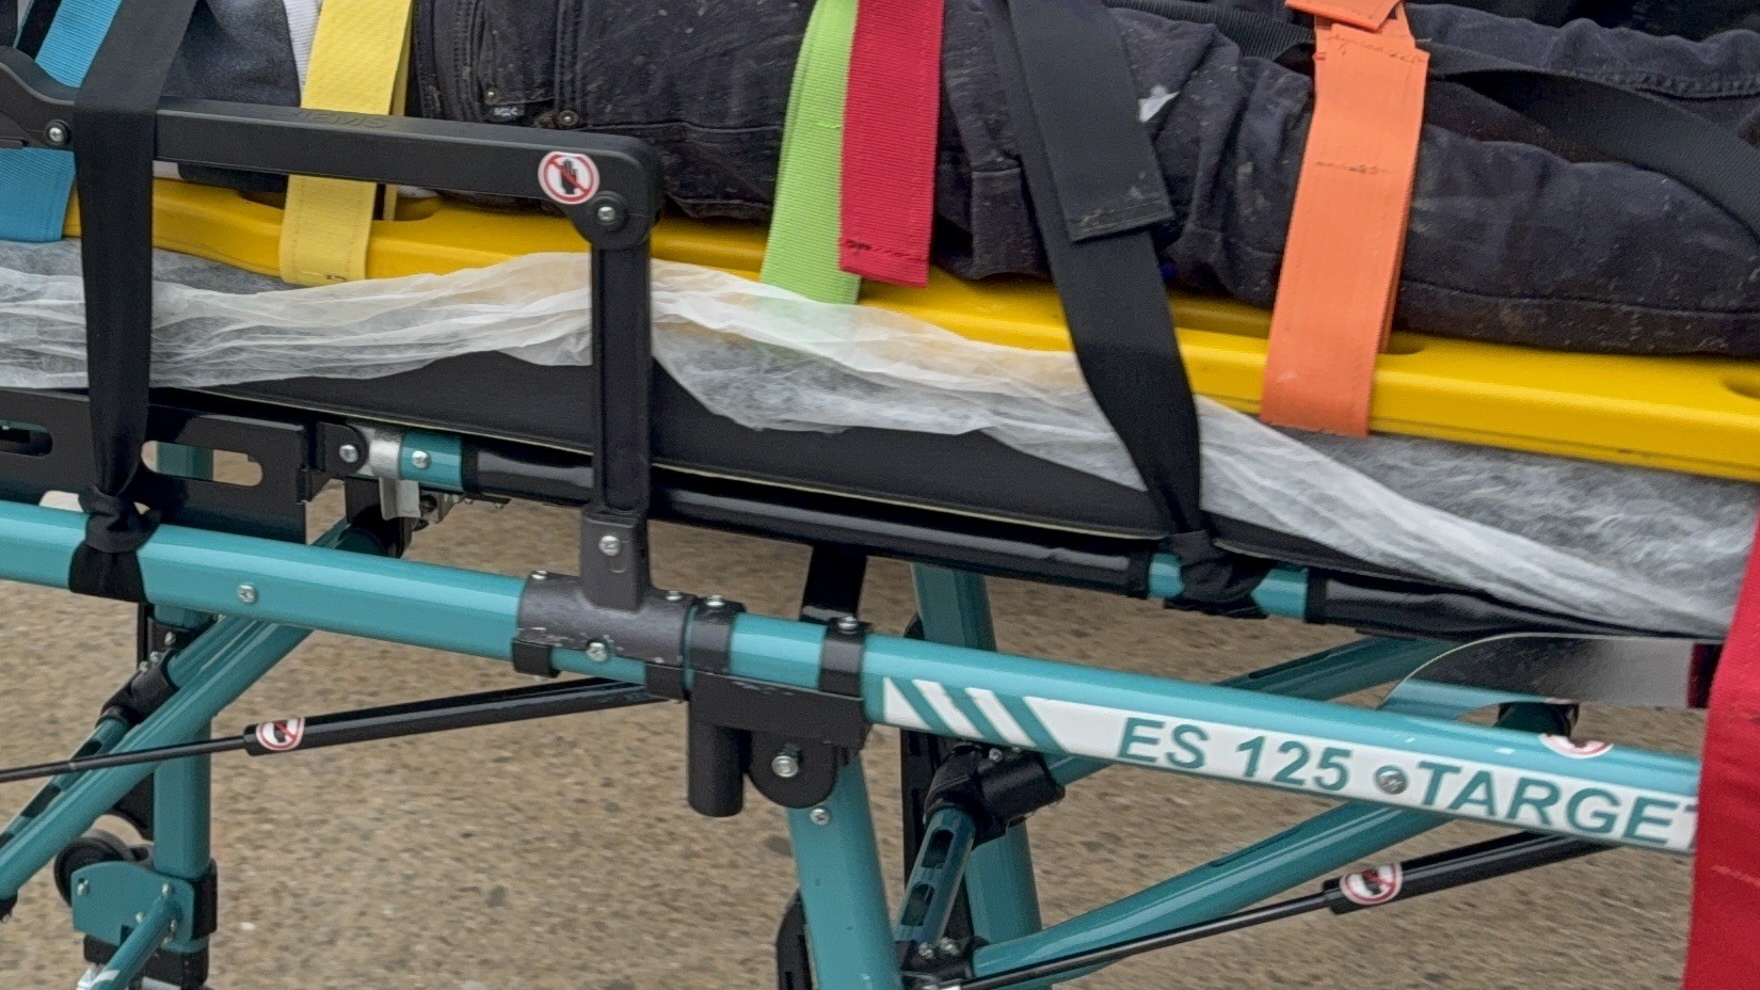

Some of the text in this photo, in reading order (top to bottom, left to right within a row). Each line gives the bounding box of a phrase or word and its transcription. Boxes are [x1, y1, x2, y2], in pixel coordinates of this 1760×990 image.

[1117, 716, 1699, 849] ES 125 TARGE
